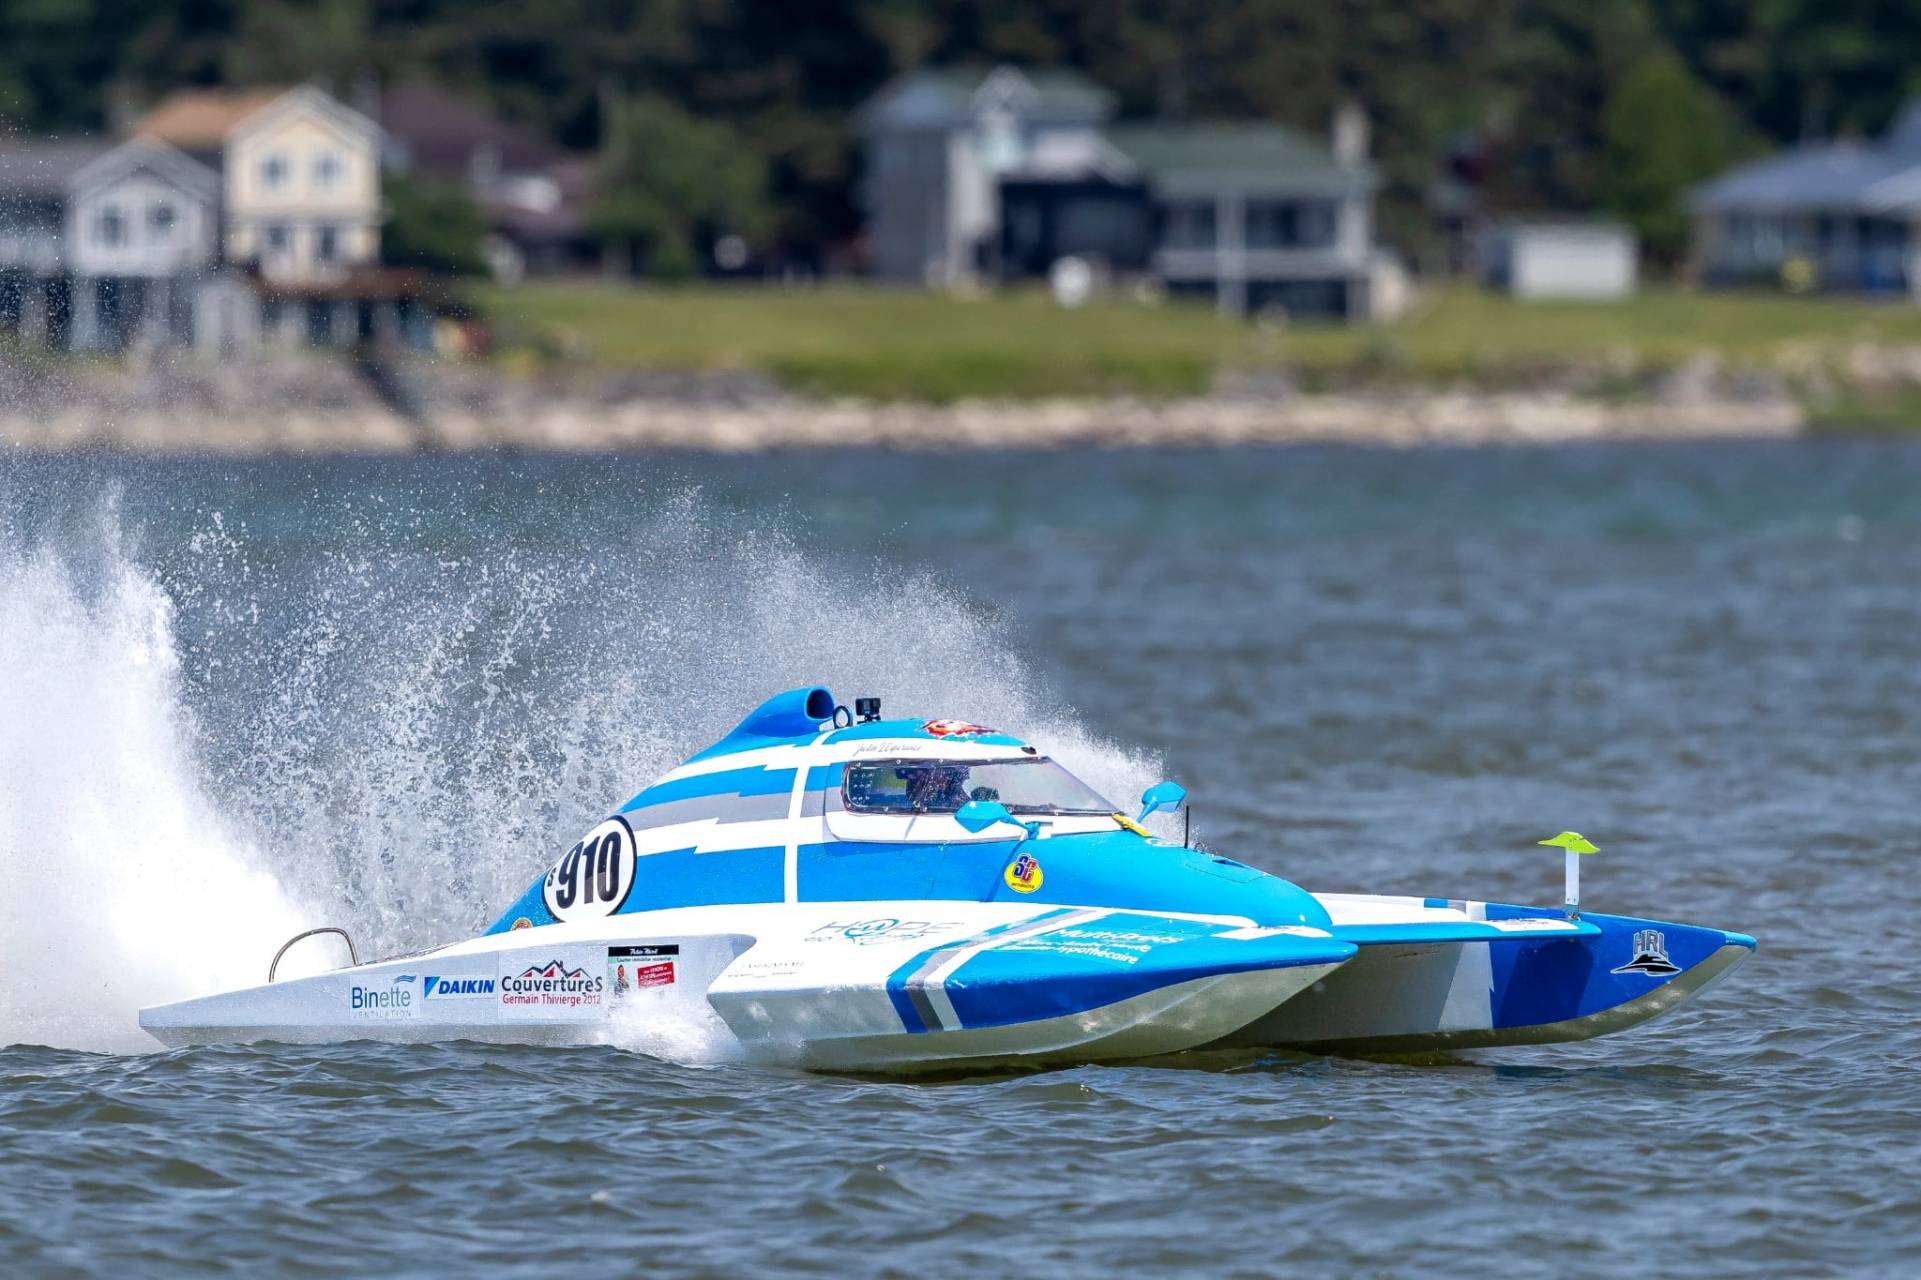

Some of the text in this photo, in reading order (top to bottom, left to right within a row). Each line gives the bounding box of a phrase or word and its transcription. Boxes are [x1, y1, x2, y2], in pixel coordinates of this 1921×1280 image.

[556, 831, 621, 909] 910
[438, 980, 495, 994] DAIKIN
[352, 987, 411, 1009] Binette
[502, 993, 539, 1005] Germain
[541, 993, 582, 1007] Thivierge
